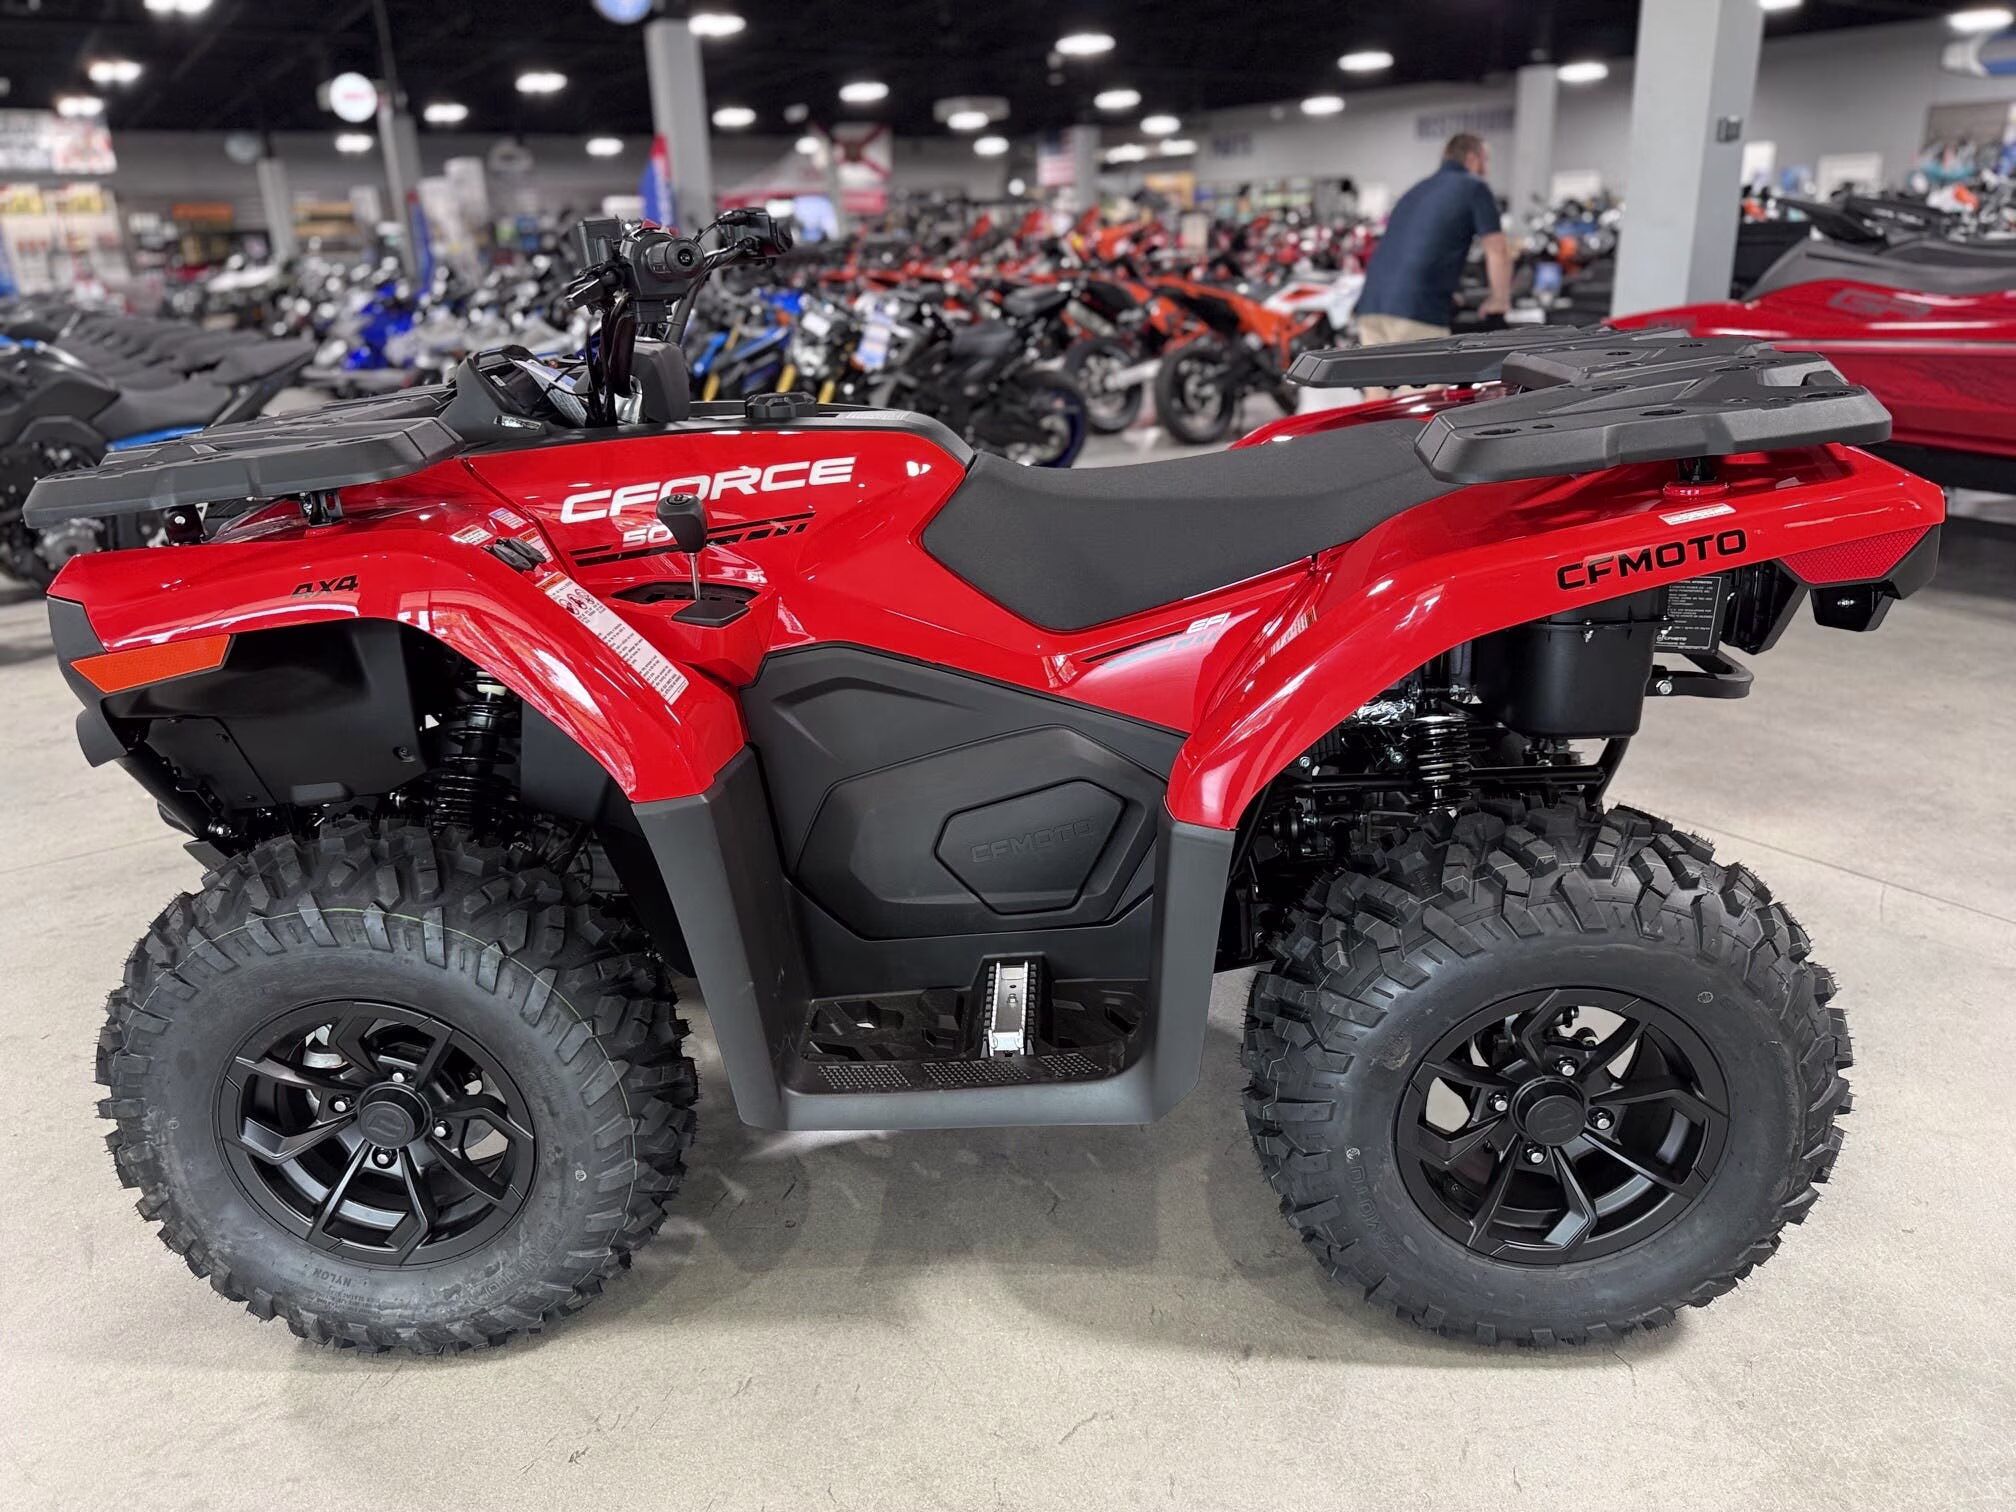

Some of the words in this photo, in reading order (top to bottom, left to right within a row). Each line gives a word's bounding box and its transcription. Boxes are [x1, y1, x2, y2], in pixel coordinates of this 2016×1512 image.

[560, 456, 857, 524] CFORCE
[622, 524, 674, 548] 50
[1556, 529, 1747, 590] CFMOTO
[1186, 612, 1231, 634] EFI
[970, 819, 1093, 863] CFMOTO
[313, 1267, 352, 1287] NYLON
